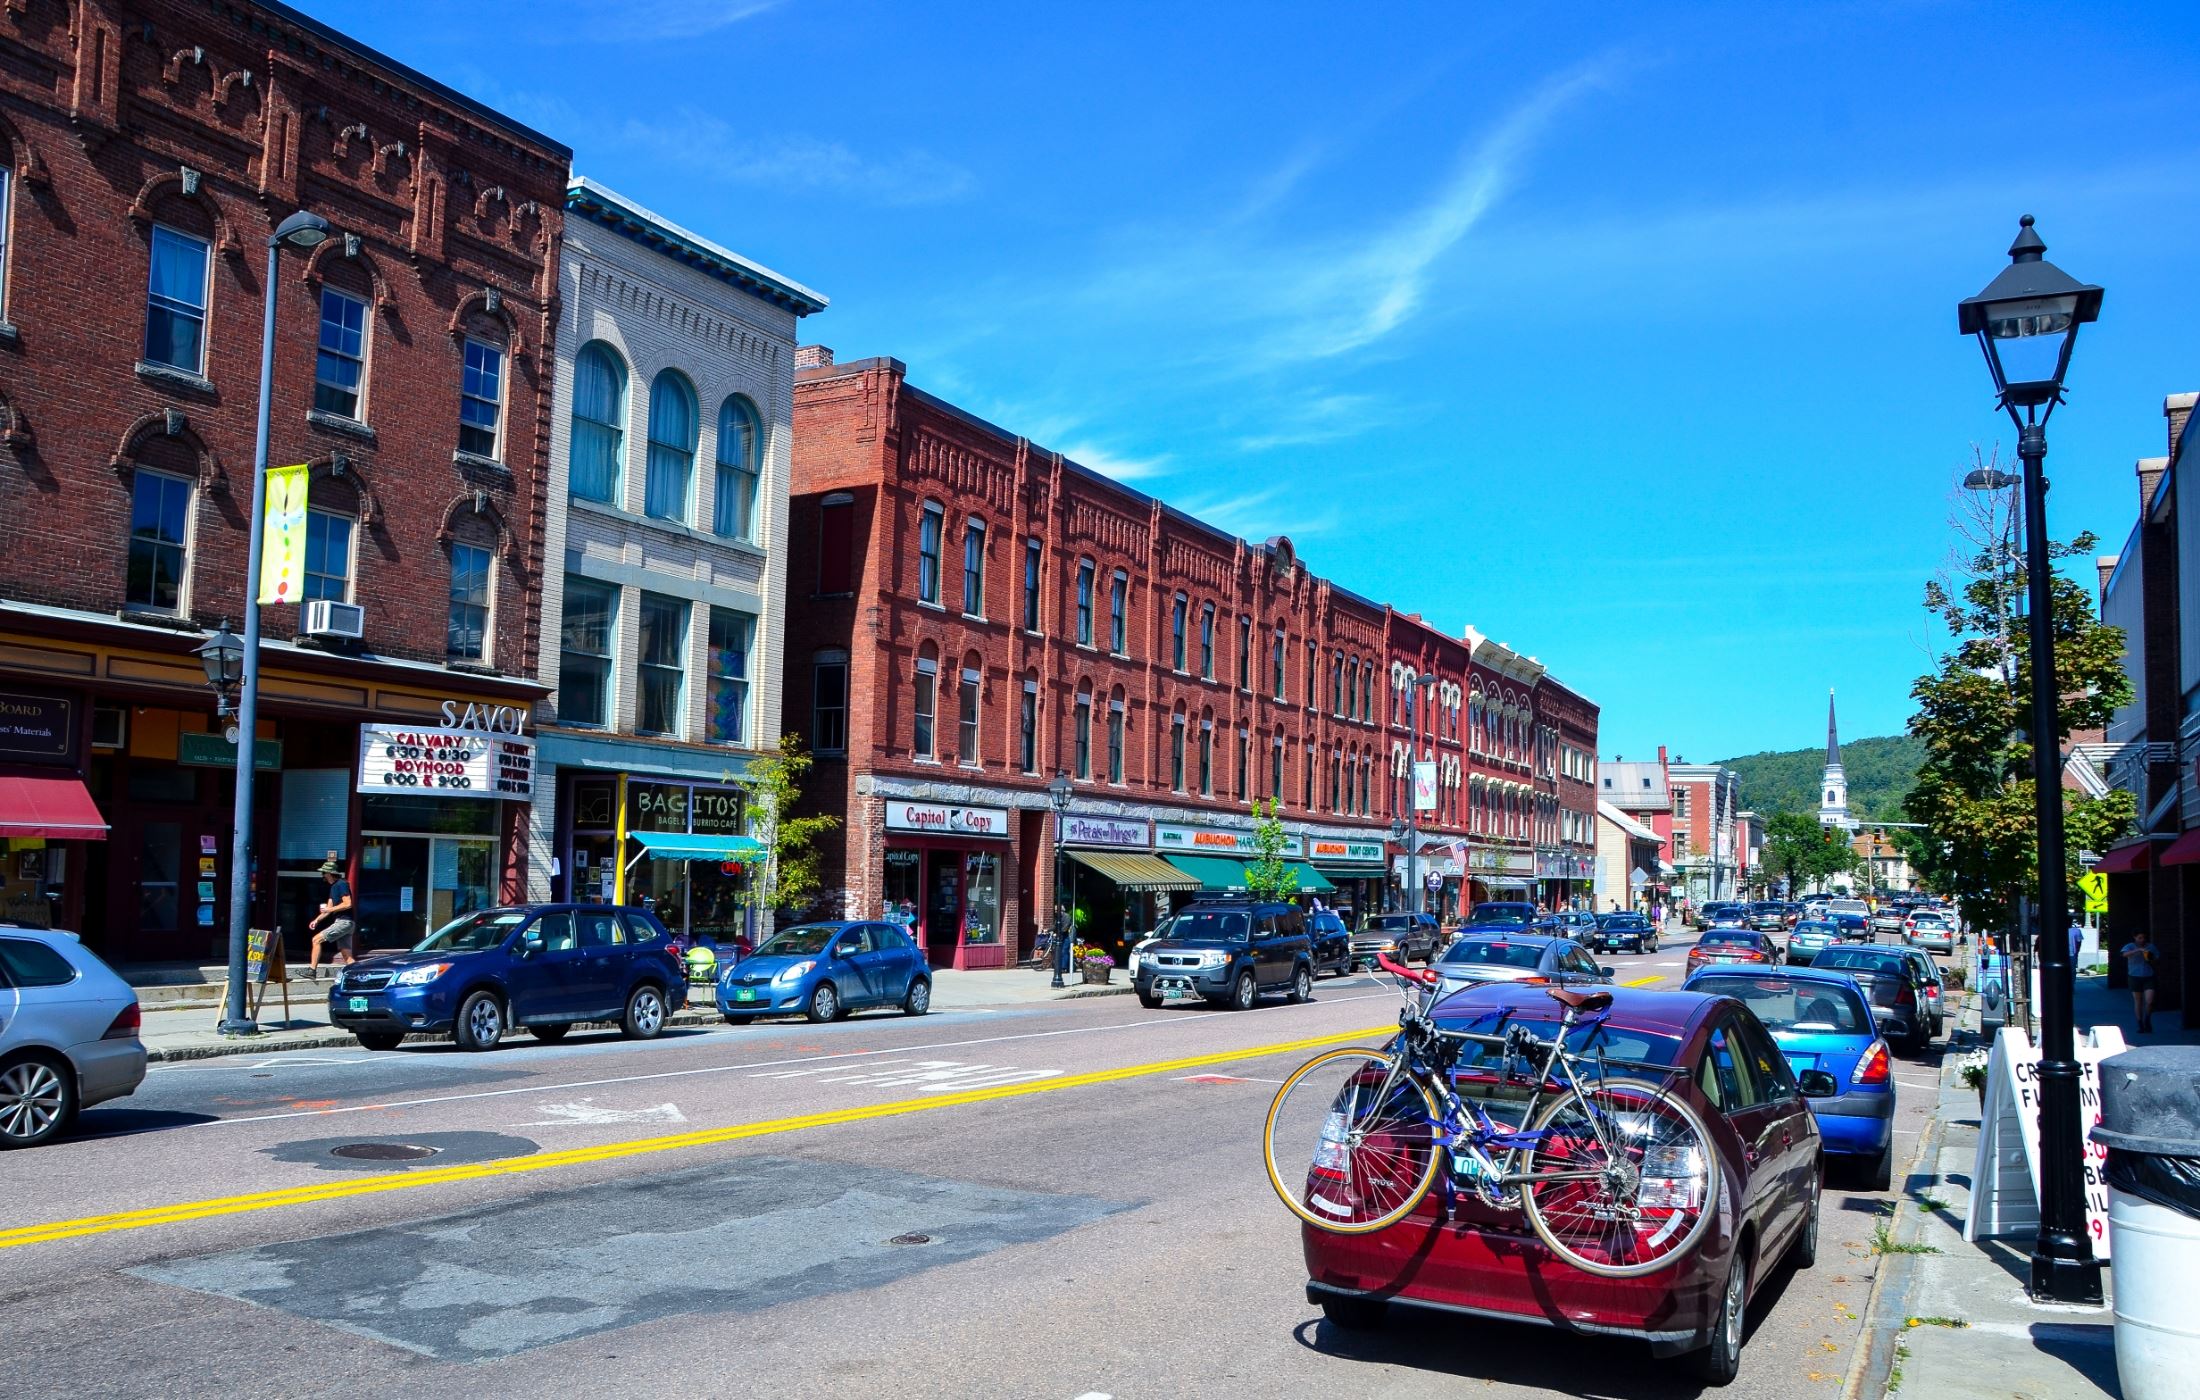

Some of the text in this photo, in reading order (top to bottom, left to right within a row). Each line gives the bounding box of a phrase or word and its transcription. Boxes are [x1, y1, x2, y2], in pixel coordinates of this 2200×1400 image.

[440, 700, 528, 736] SAVOY
[14, 726, 52, 737] Materials
[397, 733, 463, 748] CALVARY
[424, 748, 434, 760] &
[395, 760, 465, 775] BOYHOOD
[423, 775, 433, 787] &
[639, 792, 738, 817] BAGITOS
[658, 816, 680, 825] BAGEL
[693, 819, 719, 828] BURRITO
[906, 806, 992, 832] Capitol Copy
[1194, 832, 1237, 847] AUBUCHON
